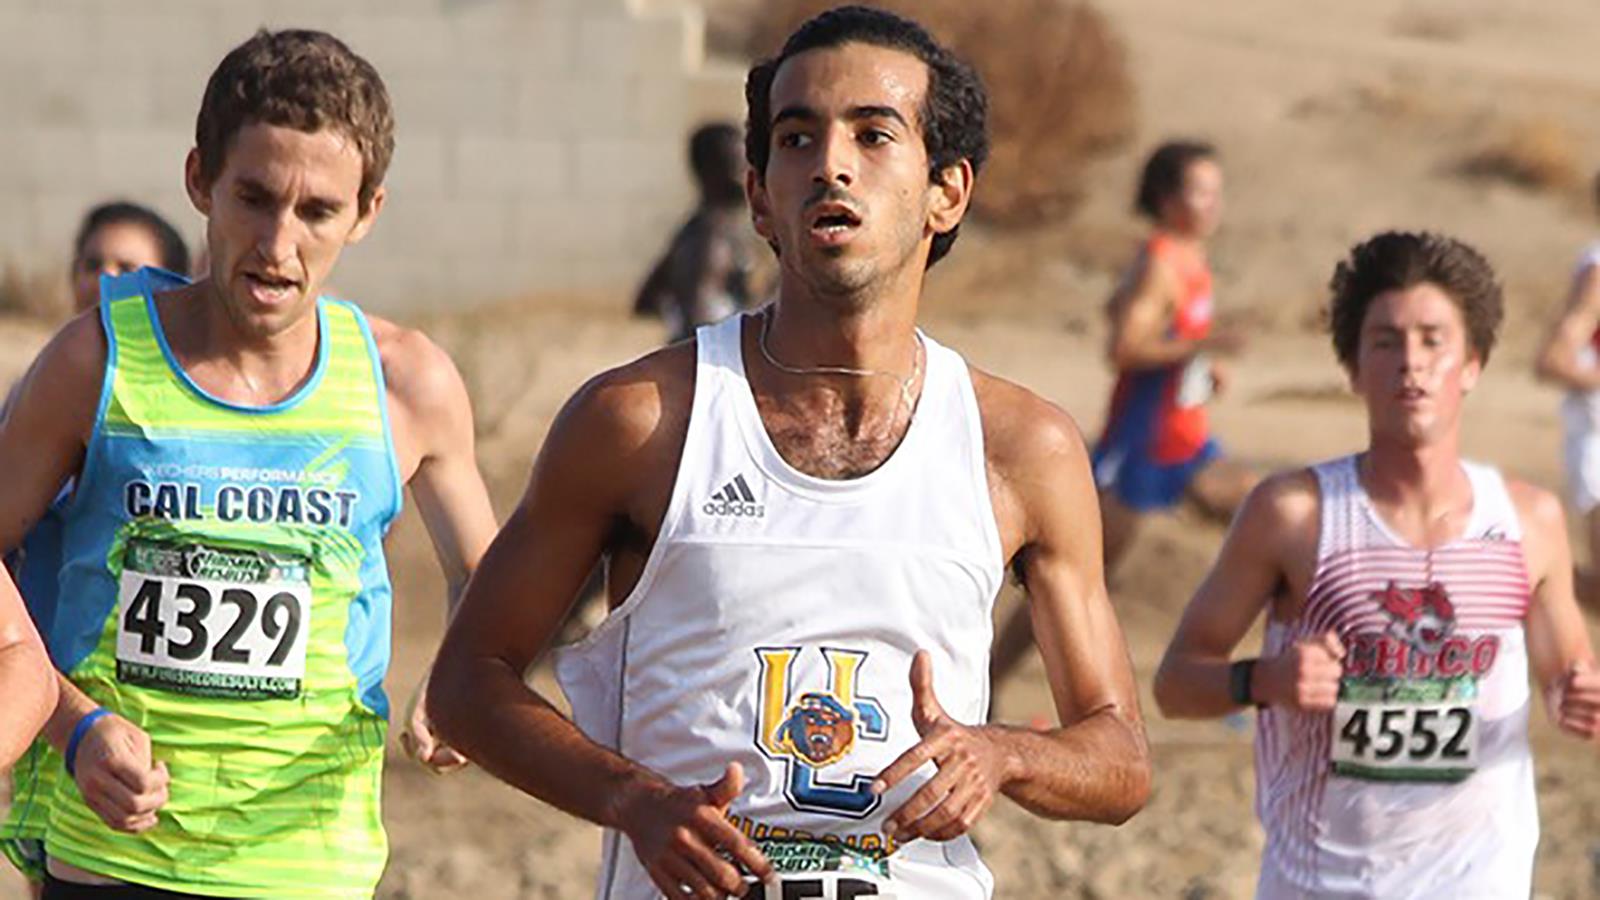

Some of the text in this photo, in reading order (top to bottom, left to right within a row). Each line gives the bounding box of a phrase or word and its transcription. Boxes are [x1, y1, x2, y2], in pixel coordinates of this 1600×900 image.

[221, 466, 338, 485] PERFORMANCE
[126, 481, 357, 527] CAL COAST
[702, 501, 765, 518] adidas
[124, 579, 301, 666] 4329
[1344, 634, 1500, 678] CHICO
[753, 646, 890, 819] UC
[1340, 707, 1472, 761] 4552
[769, 858, 825, 873] SULTS
